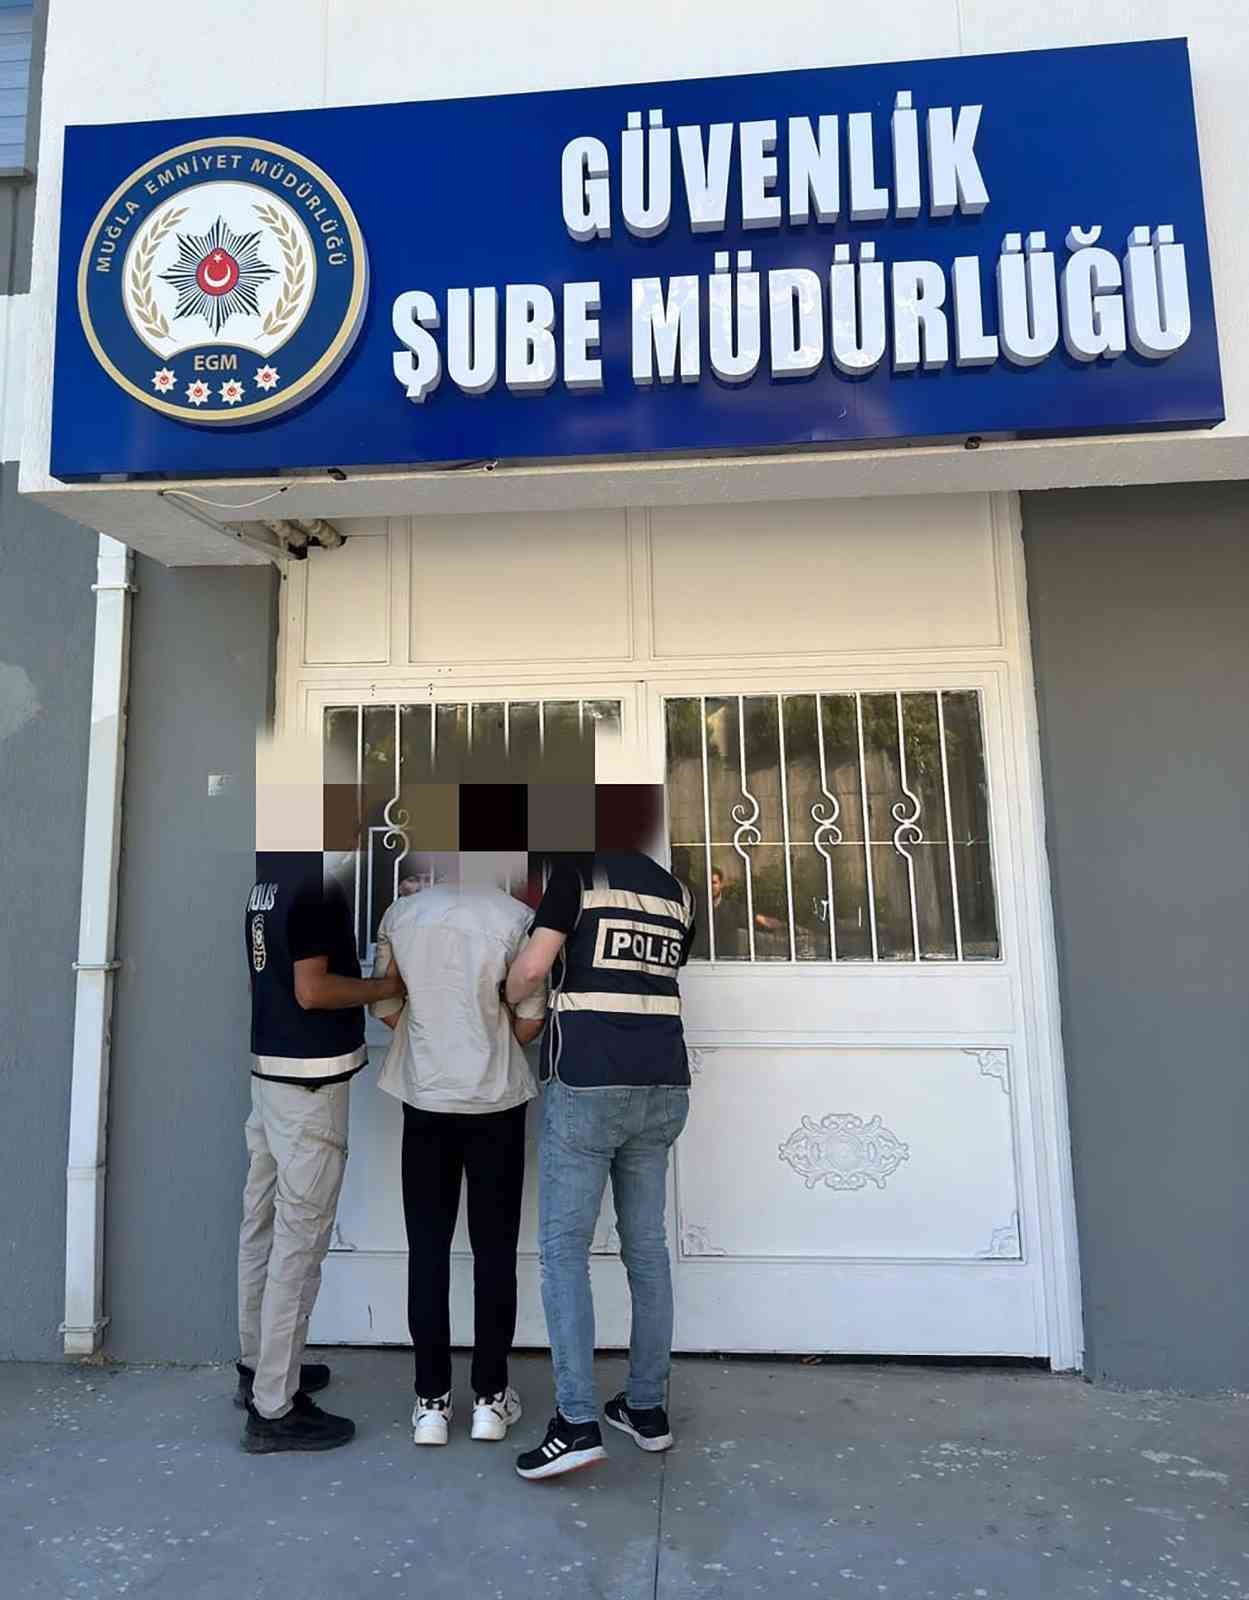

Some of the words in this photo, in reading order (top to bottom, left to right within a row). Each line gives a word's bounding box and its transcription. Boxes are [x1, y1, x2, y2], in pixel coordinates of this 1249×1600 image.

[96, 200, 140, 272] MUĞLA
[144, 155, 242, 195] EMNİYET
[250, 158, 346, 266] MÜDÜRLÜĞÜ
[561, 91, 990, 242] GÜVENLİK
[193, 354, 238, 371] EGM
[392, 287, 604, 403] ŞUBE
[631, 225, 1192, 387] MÜDÜRLÜĞÜ
